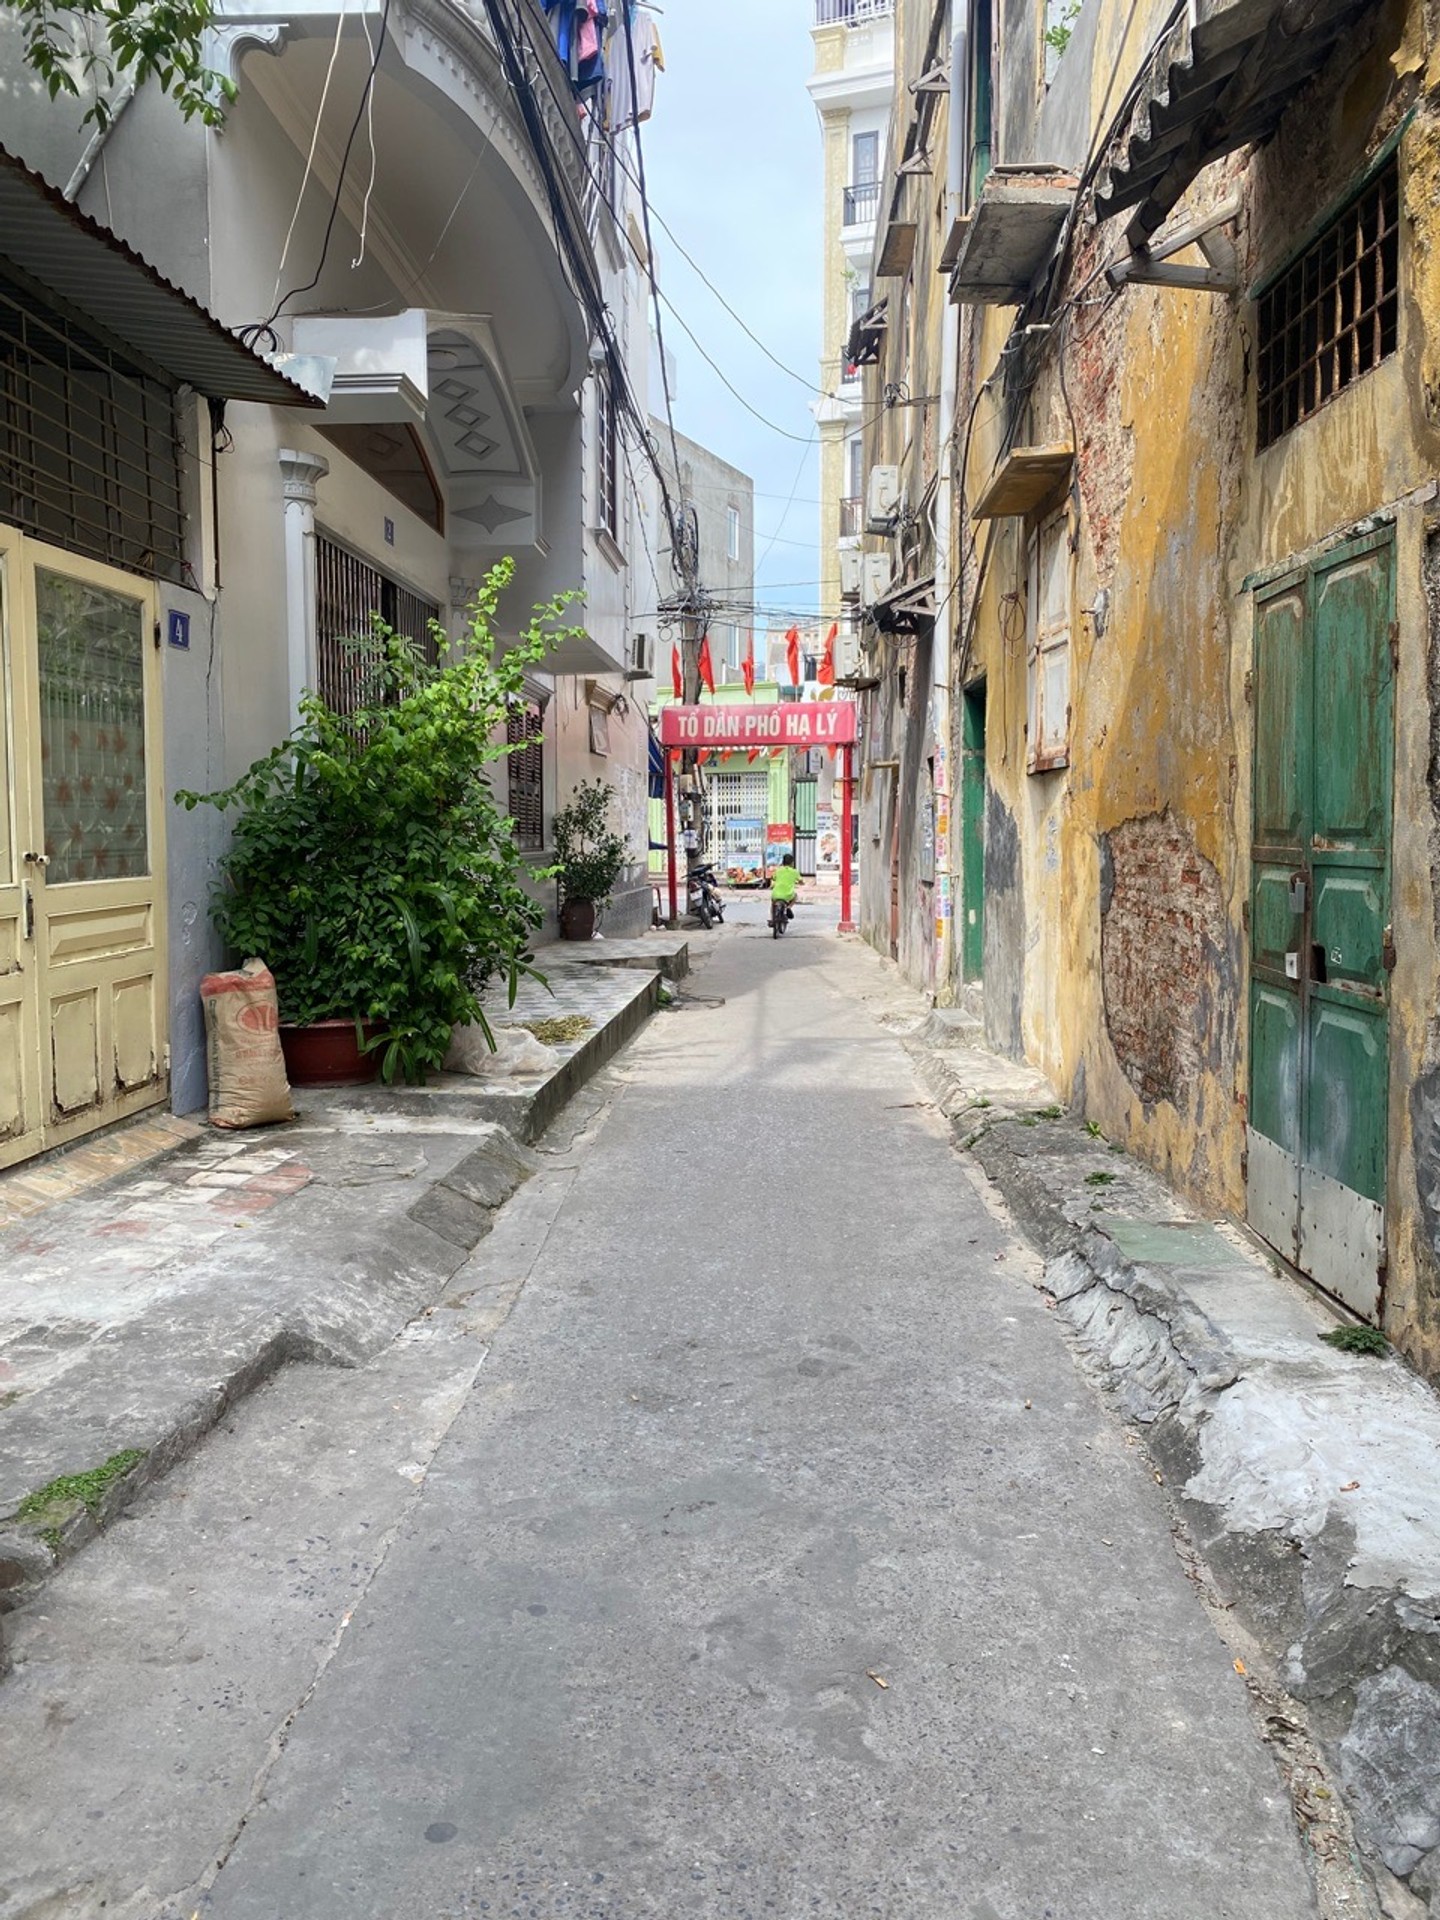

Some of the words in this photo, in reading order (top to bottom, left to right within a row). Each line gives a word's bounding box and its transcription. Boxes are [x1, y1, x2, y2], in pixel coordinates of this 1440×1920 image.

[704, 711, 739, 737] DÂN
[745, 707, 781, 737] PHỐ
[786, 713, 811, 741] HẠ
[816, 708, 838, 736] LÝ
